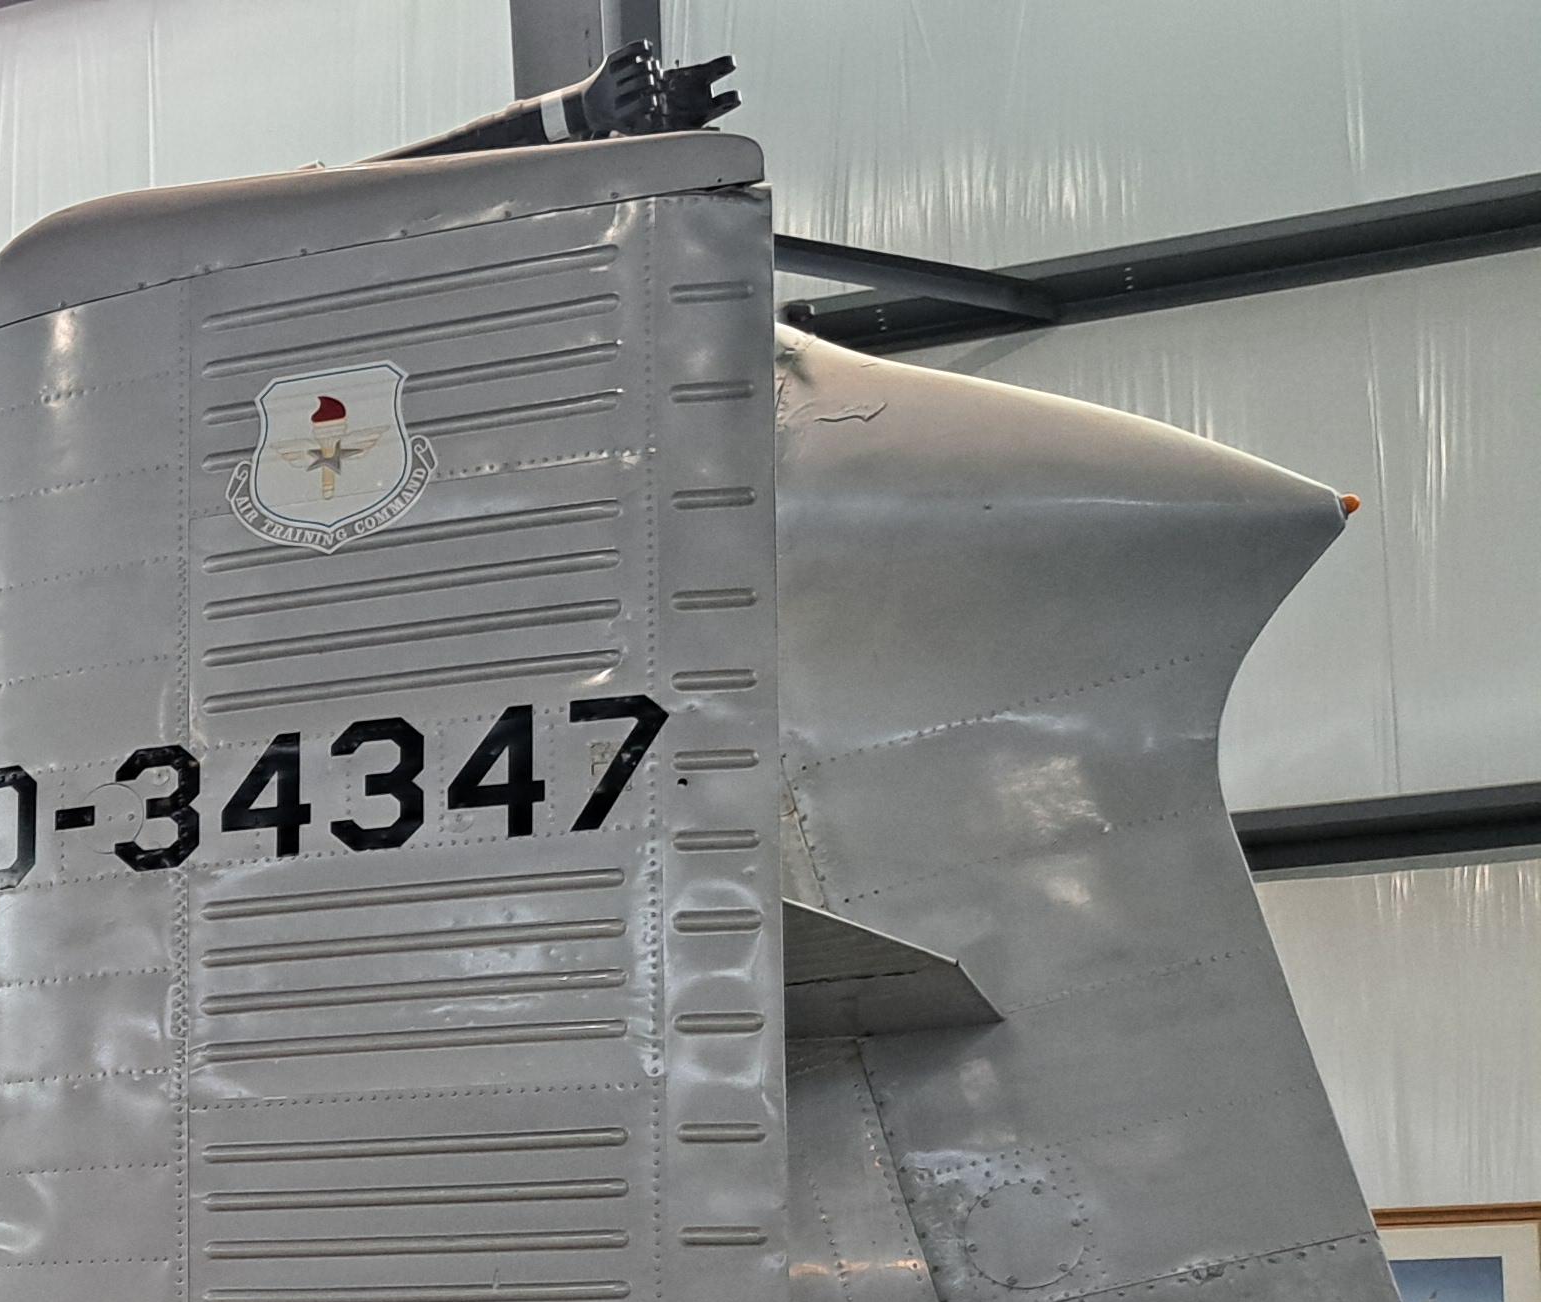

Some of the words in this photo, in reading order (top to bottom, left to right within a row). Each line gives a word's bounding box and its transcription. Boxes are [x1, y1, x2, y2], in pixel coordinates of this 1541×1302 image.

[235, 495, 259, 522] AIR
[260, 519, 348, 546] TRAINING
[353, 467, 428, 535] COMMAND
